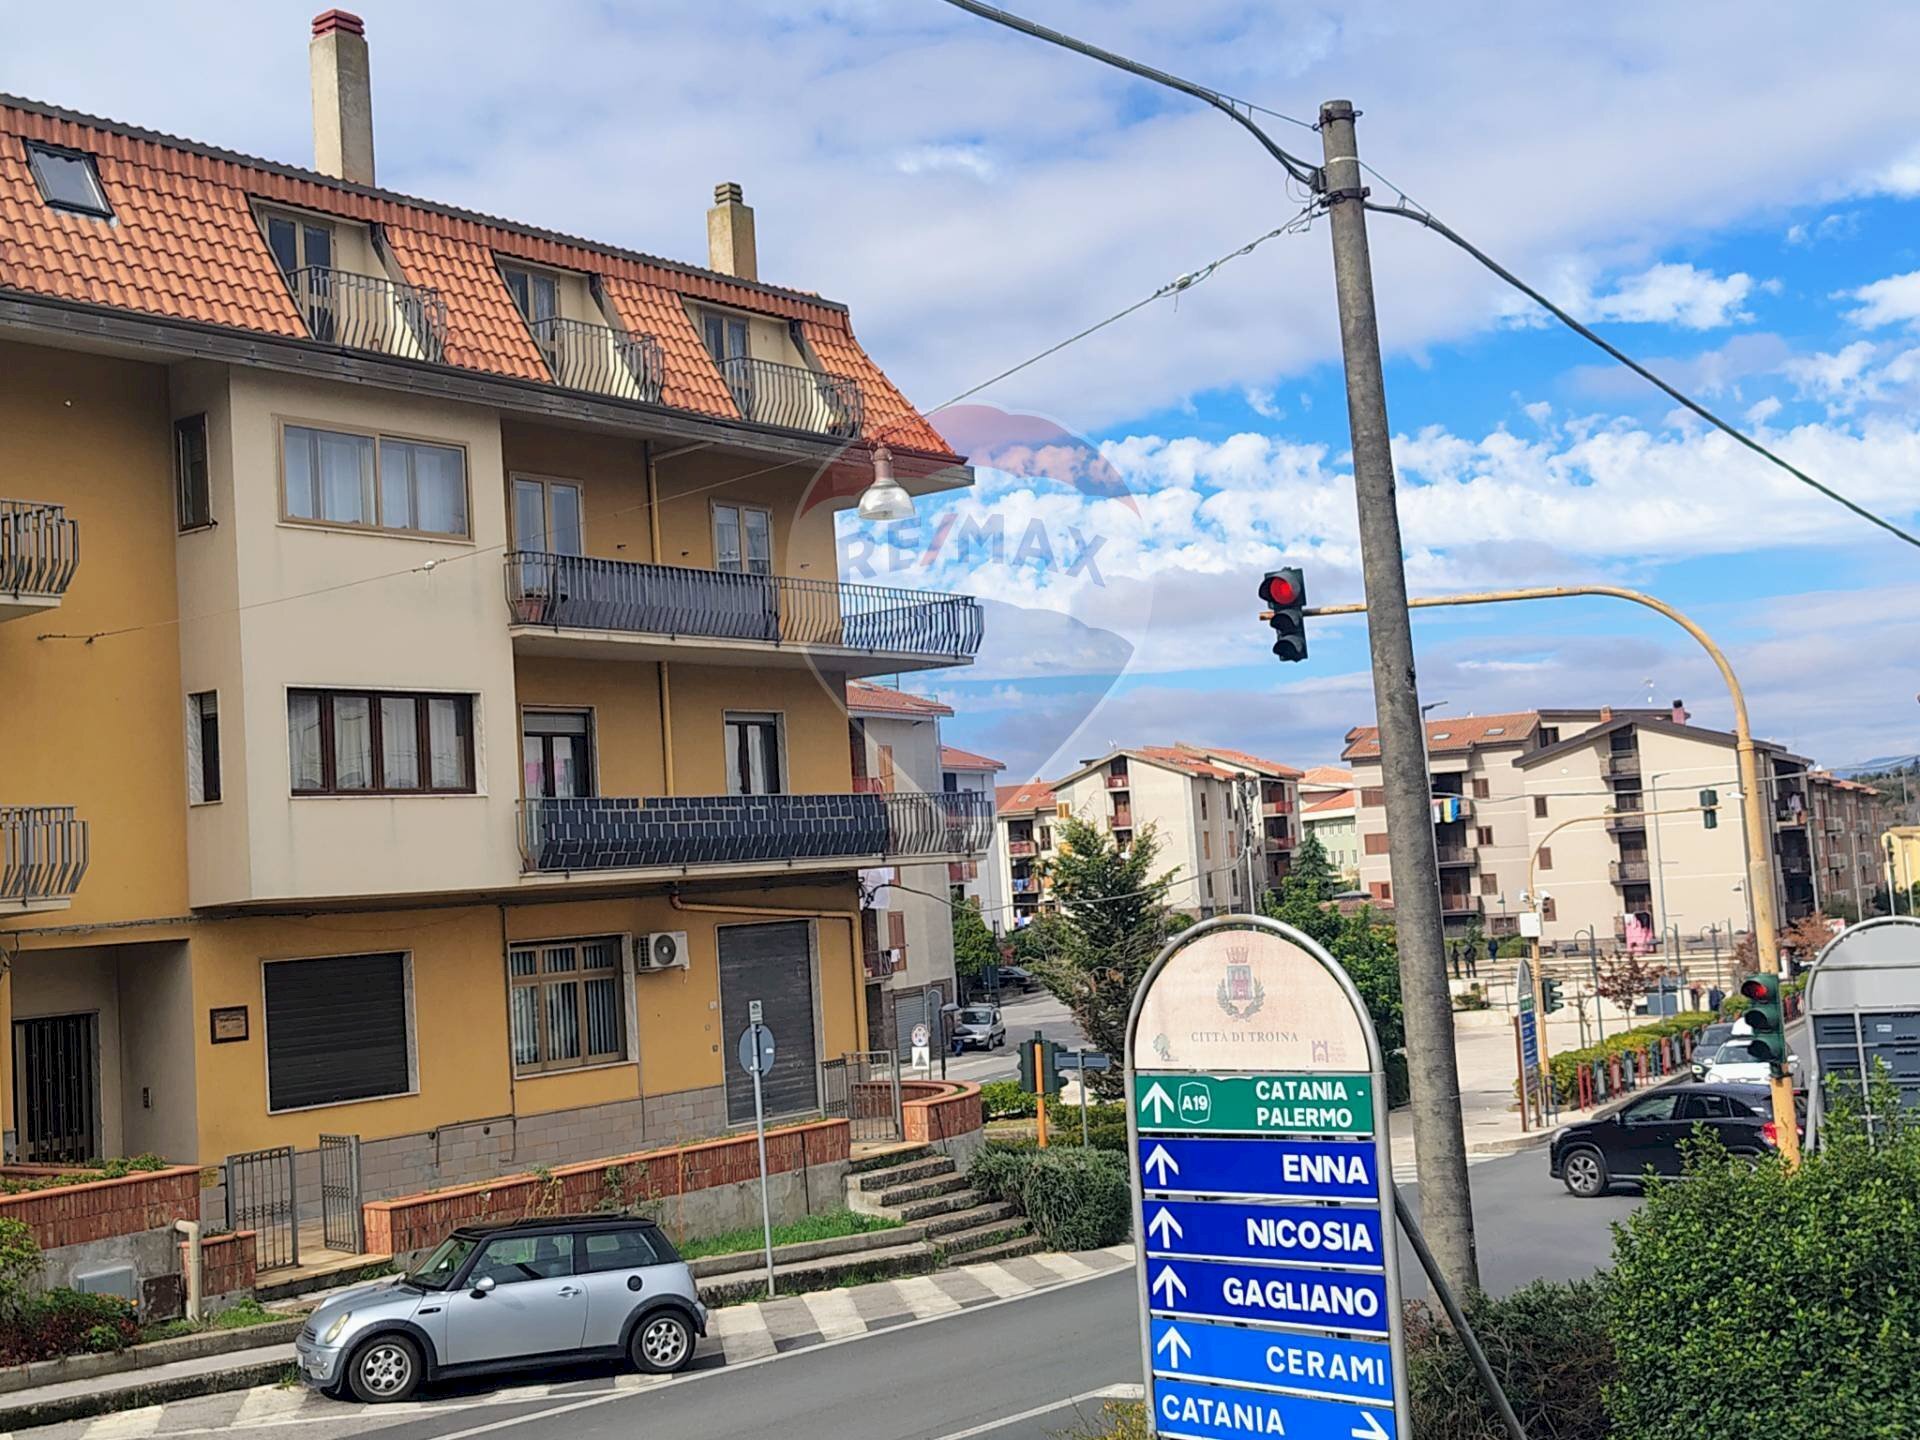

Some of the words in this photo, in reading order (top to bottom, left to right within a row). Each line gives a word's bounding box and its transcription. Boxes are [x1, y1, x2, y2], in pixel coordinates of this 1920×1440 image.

[1232, 1031, 1245, 1042] DI
[1248, 1031, 1299, 1042] TROINA
[1182, 1094, 1207, 1111] A19
[1255, 1081, 1348, 1101] CATANIA
[1256, 1107, 1352, 1128] PALERMO
[1282, 1154, 1369, 1185] ENNA
[1246, 1218, 1374, 1252] NICOSIA
[1222, 1277, 1378, 1317] GAGLIANO
[1266, 1346, 1385, 1386] CERAMI
[1161, 1394, 1285, 1436] CATANIA
